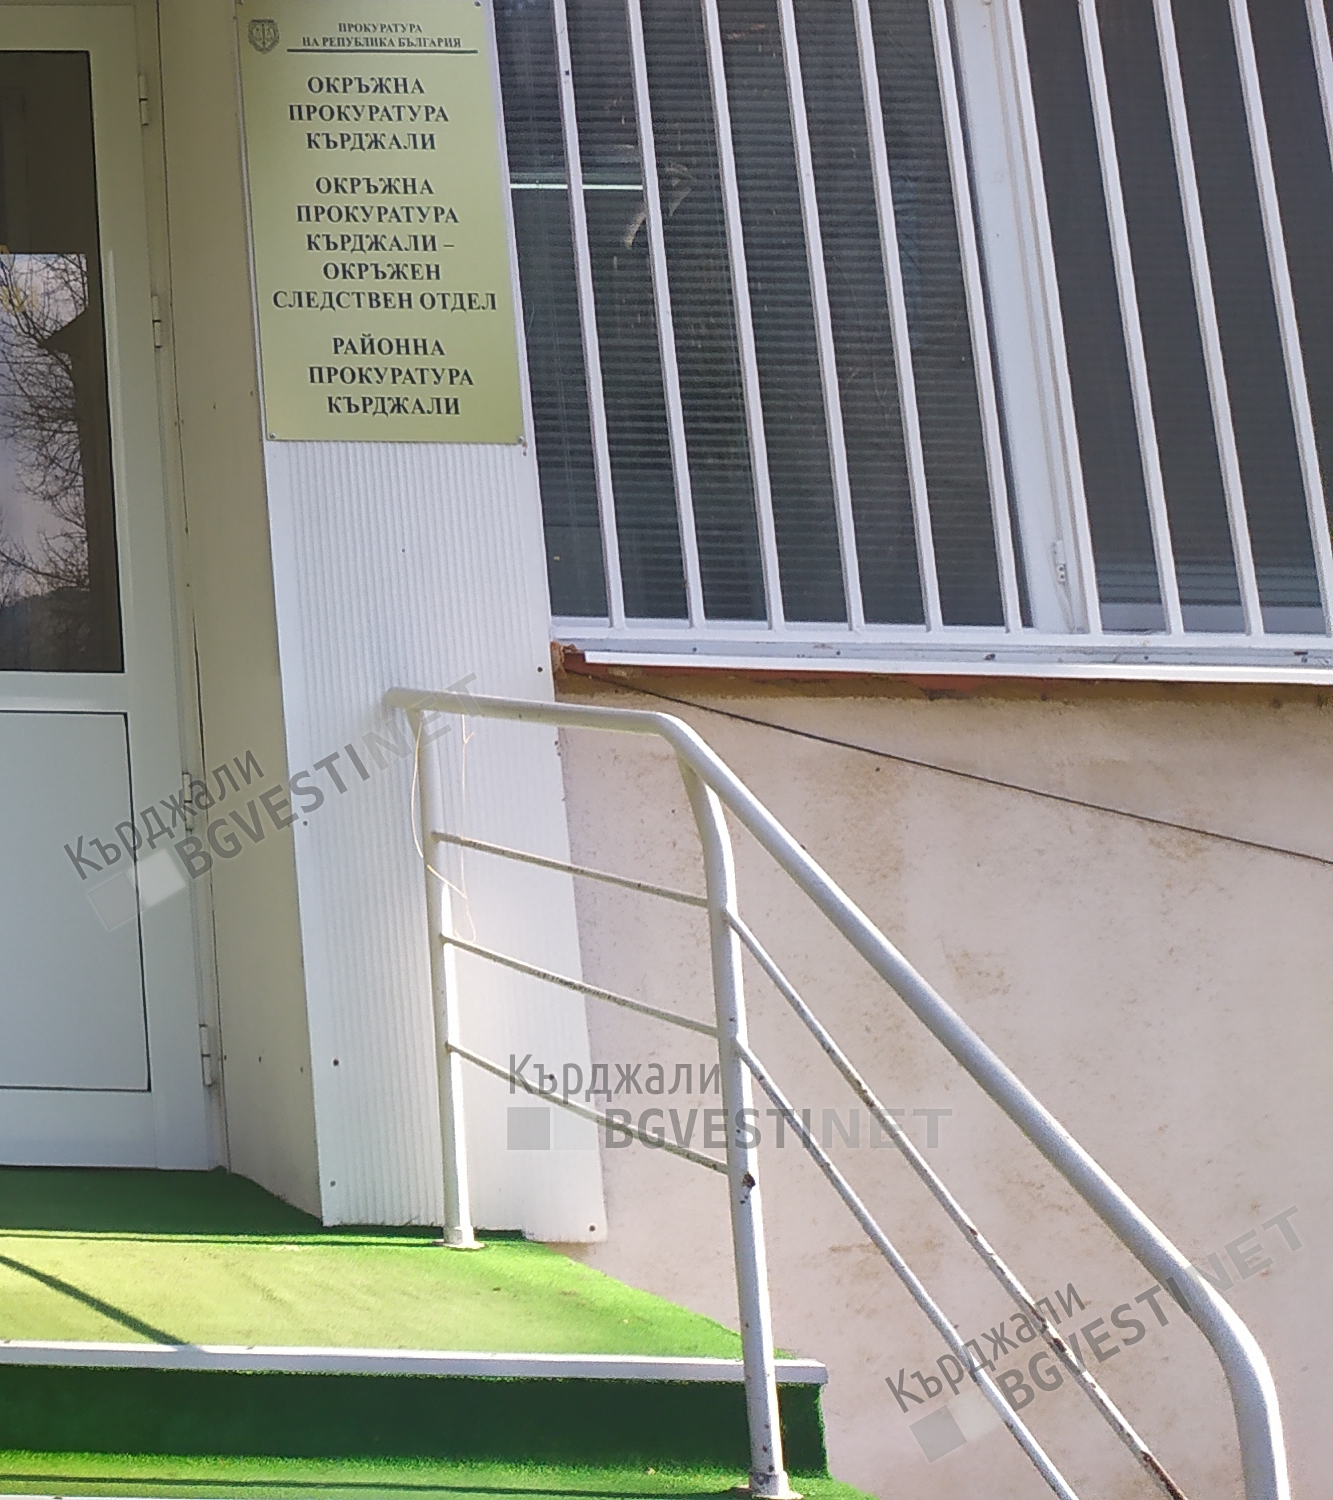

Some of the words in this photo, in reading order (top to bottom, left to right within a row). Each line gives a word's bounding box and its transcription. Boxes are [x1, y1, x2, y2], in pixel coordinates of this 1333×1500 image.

[338, 23, 422, 33] ПРОКУРАТУРА
[302, 37, 319, 47] НА
[322, 37, 395, 48] РЕПУБЛИКА
[398, 38, 462, 48] БЪЛГАРИЯ
[307, 76, 425, 94] ОКРЪЖНА
[289, 104, 449, 122] ПРОКУРАТУРА
[306, 132, 436, 151] КЪРДЖАЛИ
[315, 177, 434, 196] ОКРЪЖНА
[296, 205, 459, 224] ПРОКУРАТУРА
[306, 233, 438, 253] КЪРДЖАЛИ
[322, 262, 441, 281] ОКРЪЖЕН
[272, 291, 412, 311] СЛЕДСТВЕН
[419, 292, 497, 311] ОТДЕЛ
[332, 333, 445, 356] РАЙОННА
[309, 366, 474, 386] ПРОКУРАТУРА
[327, 396, 461, 417] КЪРДЖАЛИ
